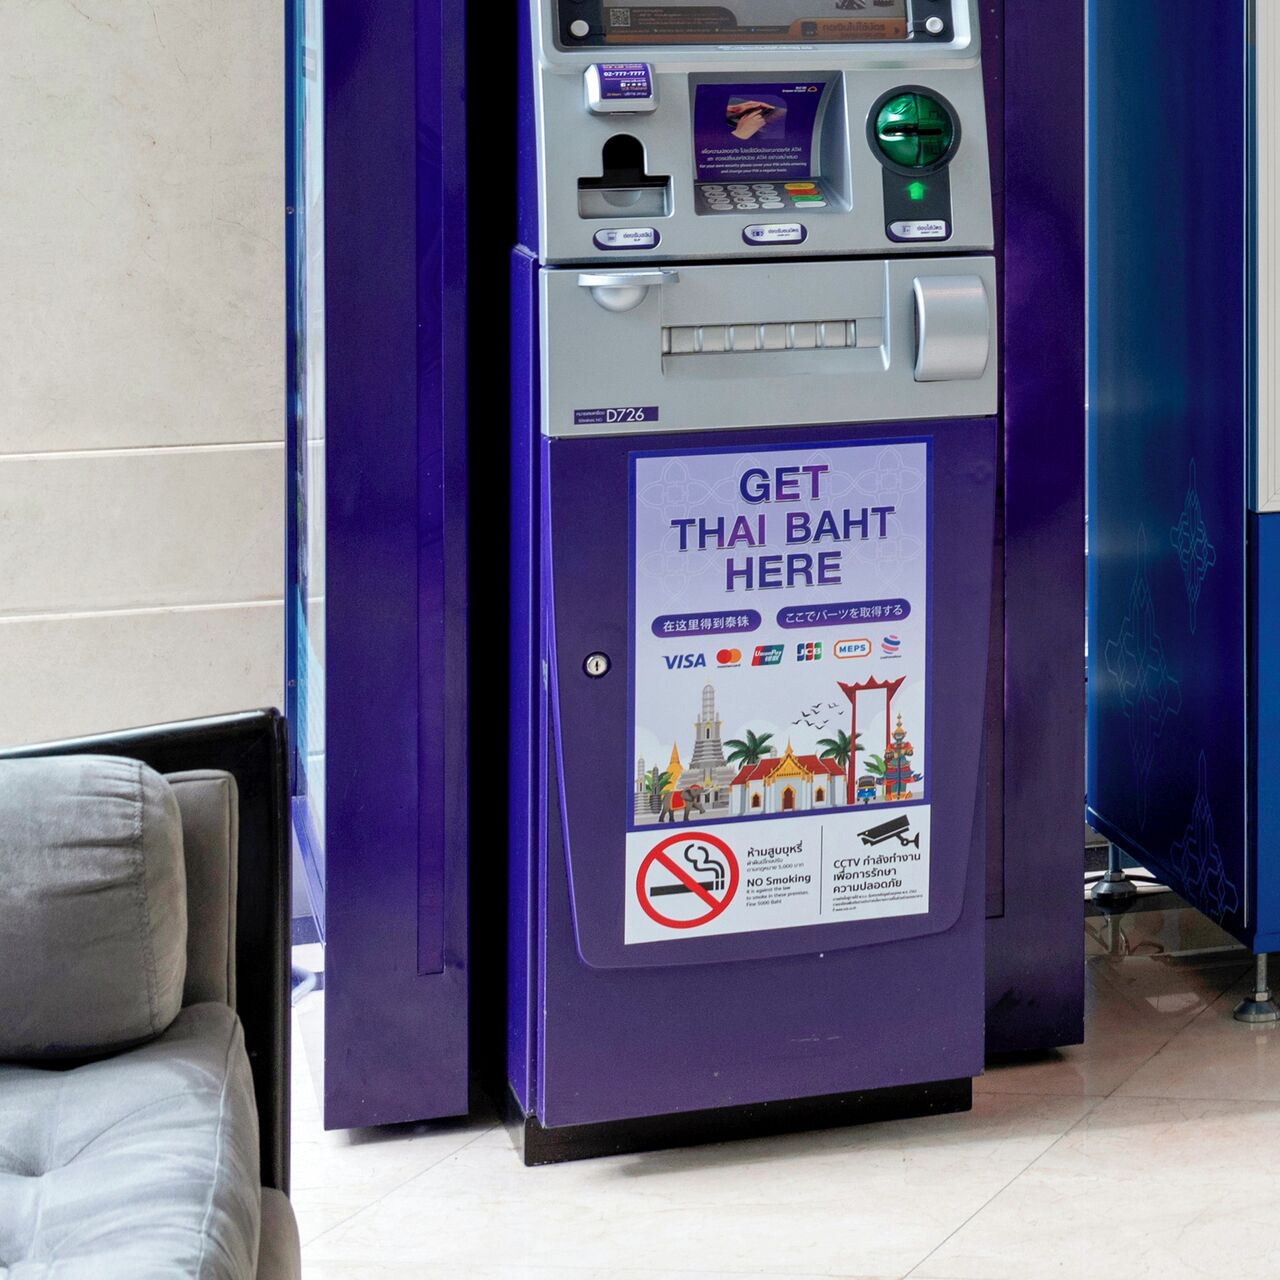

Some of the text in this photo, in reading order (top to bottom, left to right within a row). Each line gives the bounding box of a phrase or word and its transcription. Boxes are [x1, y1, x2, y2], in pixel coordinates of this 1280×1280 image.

[606, 407, 645, 423] D726
[740, 464, 829, 505] GET
[670, 506, 896, 552] THAI BAHT
[725, 551, 843, 593] HERE
[785, 604, 903, 624] ここでバーツを取得する
[663, 614, 750, 633] 在这里得到泰铢
[798, 646, 823, 657] JCB
[838, 644, 866, 654] MEPS
[661, 653, 707, 670] VISA
[747, 840, 803, 858] ห้ามสูบบุหรี่
[833, 853, 921, 869] CCTV กำลังทำงาน
[747, 874, 811, 887] NO Smoking
[833, 867, 897, 881] เพื่อการรักษา
[833, 878, 902, 893] ความปลอดภัย
